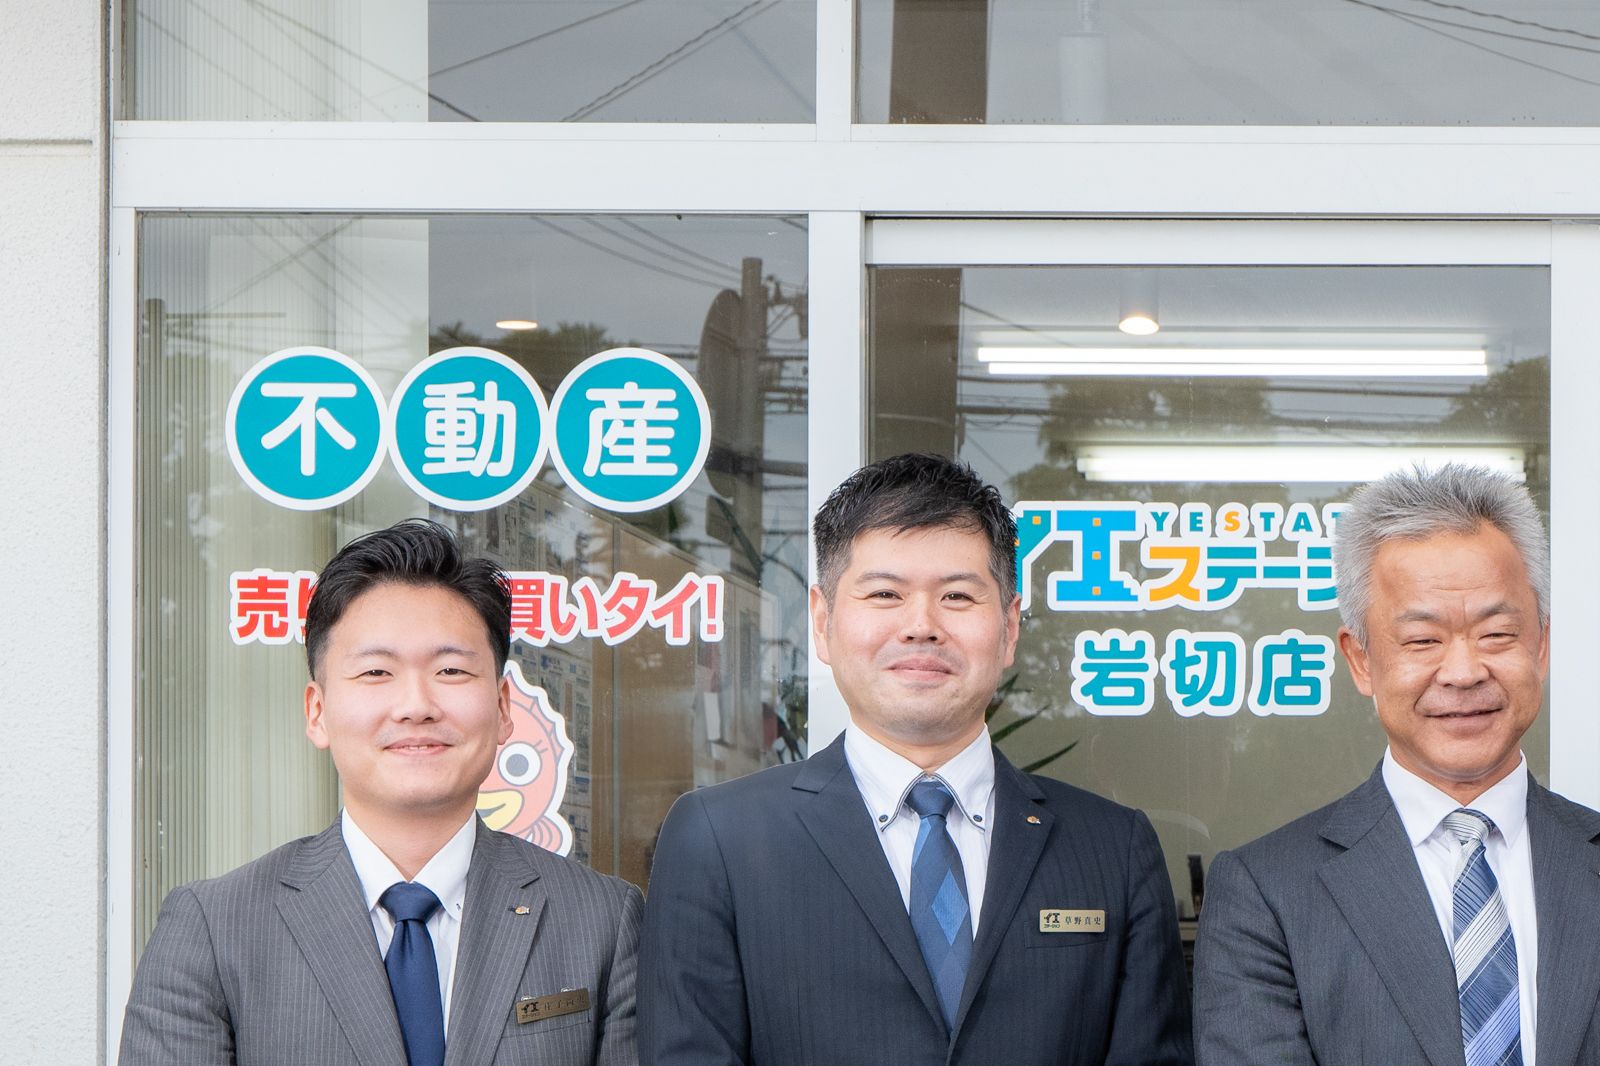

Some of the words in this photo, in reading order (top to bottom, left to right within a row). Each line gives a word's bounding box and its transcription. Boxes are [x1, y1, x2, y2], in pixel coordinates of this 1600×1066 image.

[256, 376, 683, 482] 不動産
[1080, 637, 1326, 707] 岩切店
